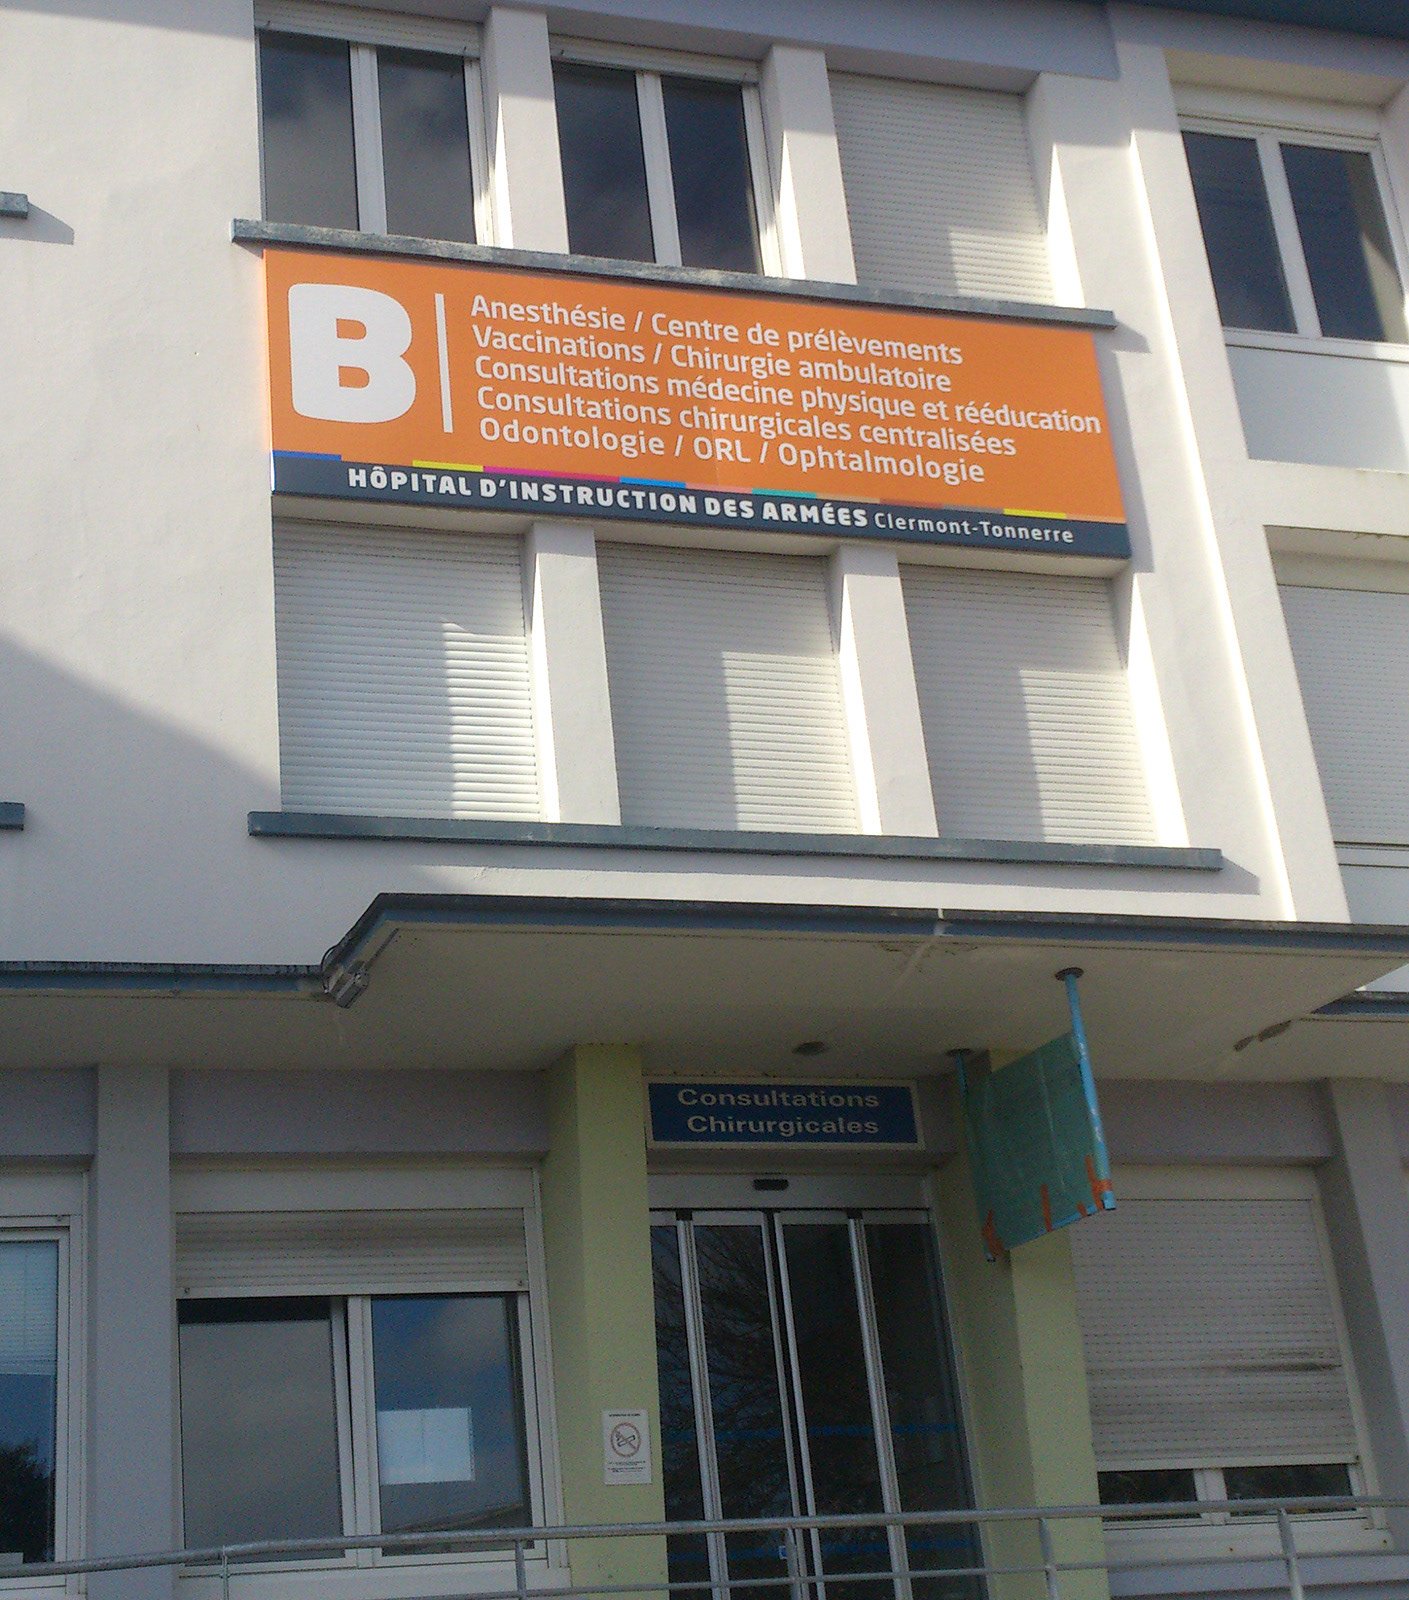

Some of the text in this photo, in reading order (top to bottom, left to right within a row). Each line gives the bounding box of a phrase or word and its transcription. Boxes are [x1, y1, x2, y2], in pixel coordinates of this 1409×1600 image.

[288, 283, 416, 424] B
[471, 294, 964, 366] Anesthésie / Centre de prélèvements
[473, 325, 952, 393] Vaccinations / Chirurgie ambulatoire
[475, 356, 1102, 435] Consultations médecine physique et rééducation
[478, 386, 1017, 457] Consultations chirurgicales centralisées
[480, 417, 985, 486] Odontologie / ORL / Ophtalmologie
[348, 466, 472, 497] HÔPITAL
[704, 497, 755, 519] DES
[762, 502, 869, 528] ARMÉES
[874, 513, 1075, 545] Clermont-Tonnerre
[677, 1088, 880, 1108] Consultations
[687, 1115, 880, 1138] Chirurgicales
